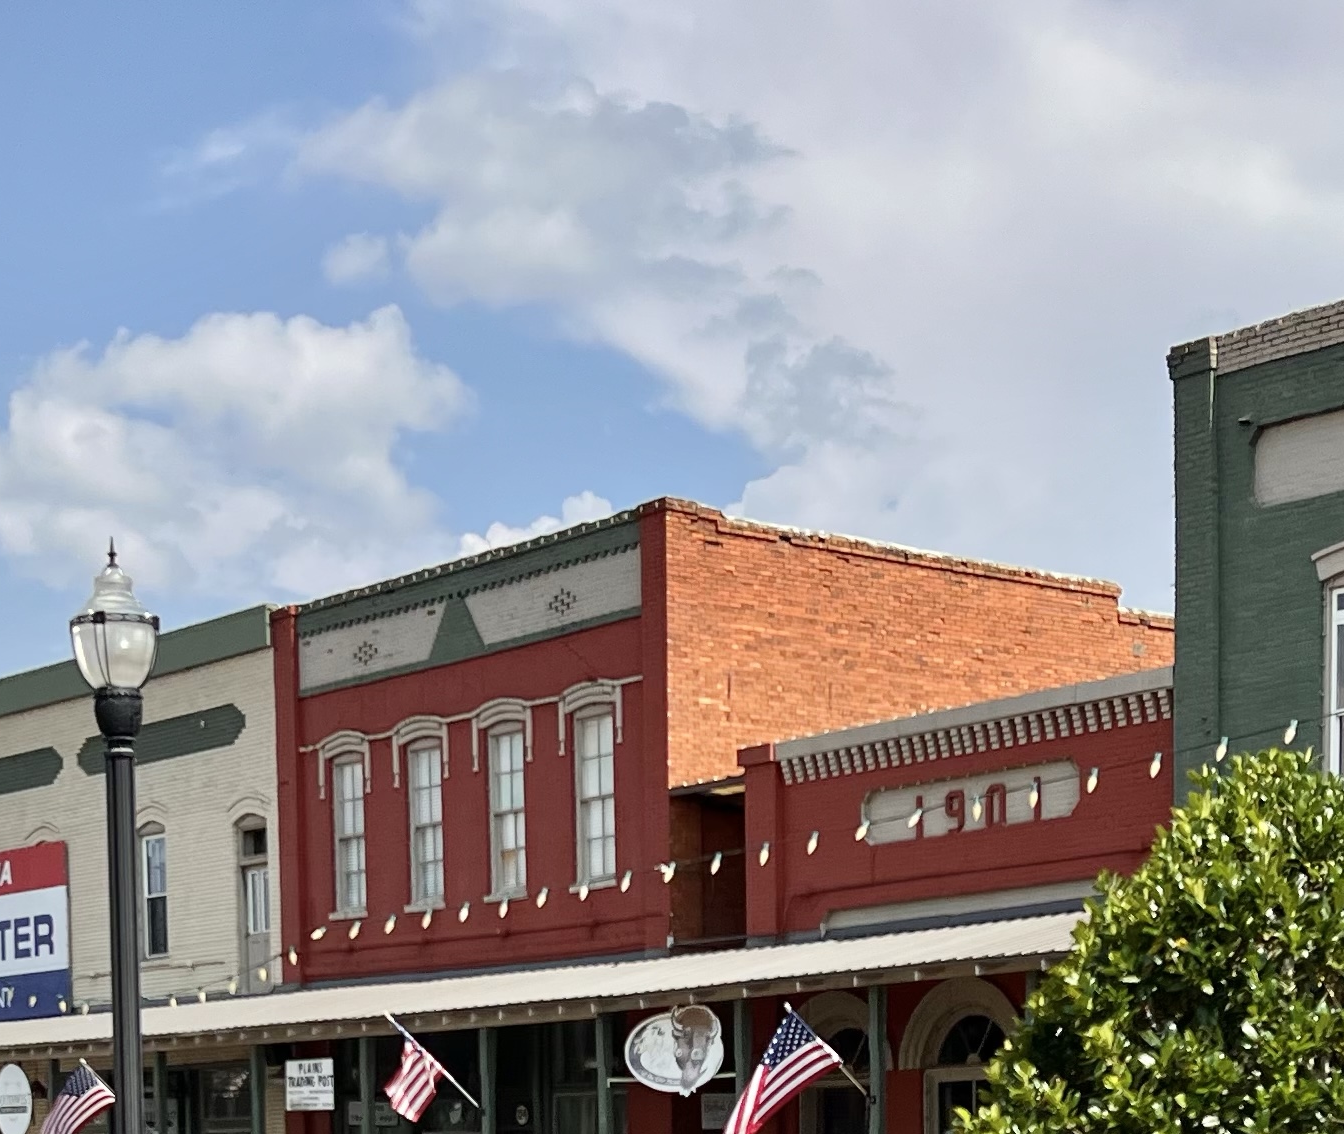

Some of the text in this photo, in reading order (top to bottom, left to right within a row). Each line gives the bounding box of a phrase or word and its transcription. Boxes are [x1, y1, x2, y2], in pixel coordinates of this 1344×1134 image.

[915, 776, 1042, 840] 1901
[298, 1062, 323, 1074] PLAINS
[288, 1074, 334, 1087] TRADING POST
